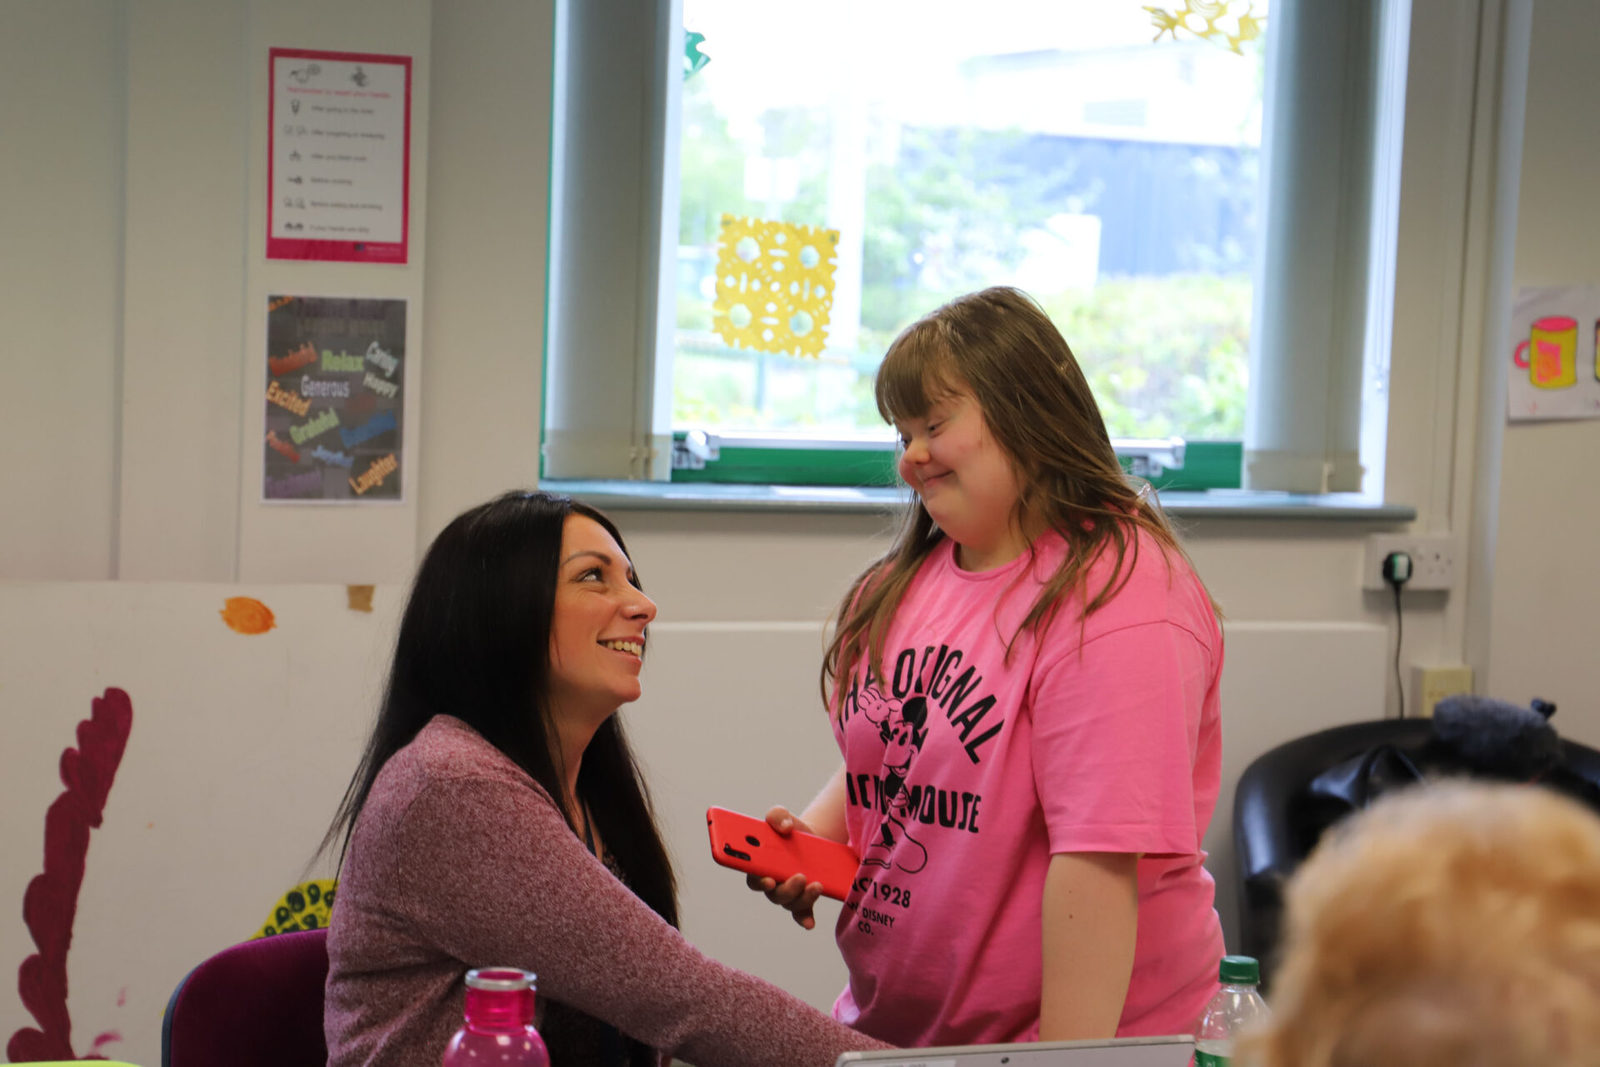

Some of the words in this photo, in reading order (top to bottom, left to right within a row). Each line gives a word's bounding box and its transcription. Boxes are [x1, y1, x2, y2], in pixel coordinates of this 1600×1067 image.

[321, 349, 365, 372] Relax
[300, 374, 351, 398] Generous
[348, 452, 399, 496] Laughter
[873, 881, 911, 908] 1928
[857, 920, 875, 936] CO.
[862, 907, 895, 928] DISNEY
